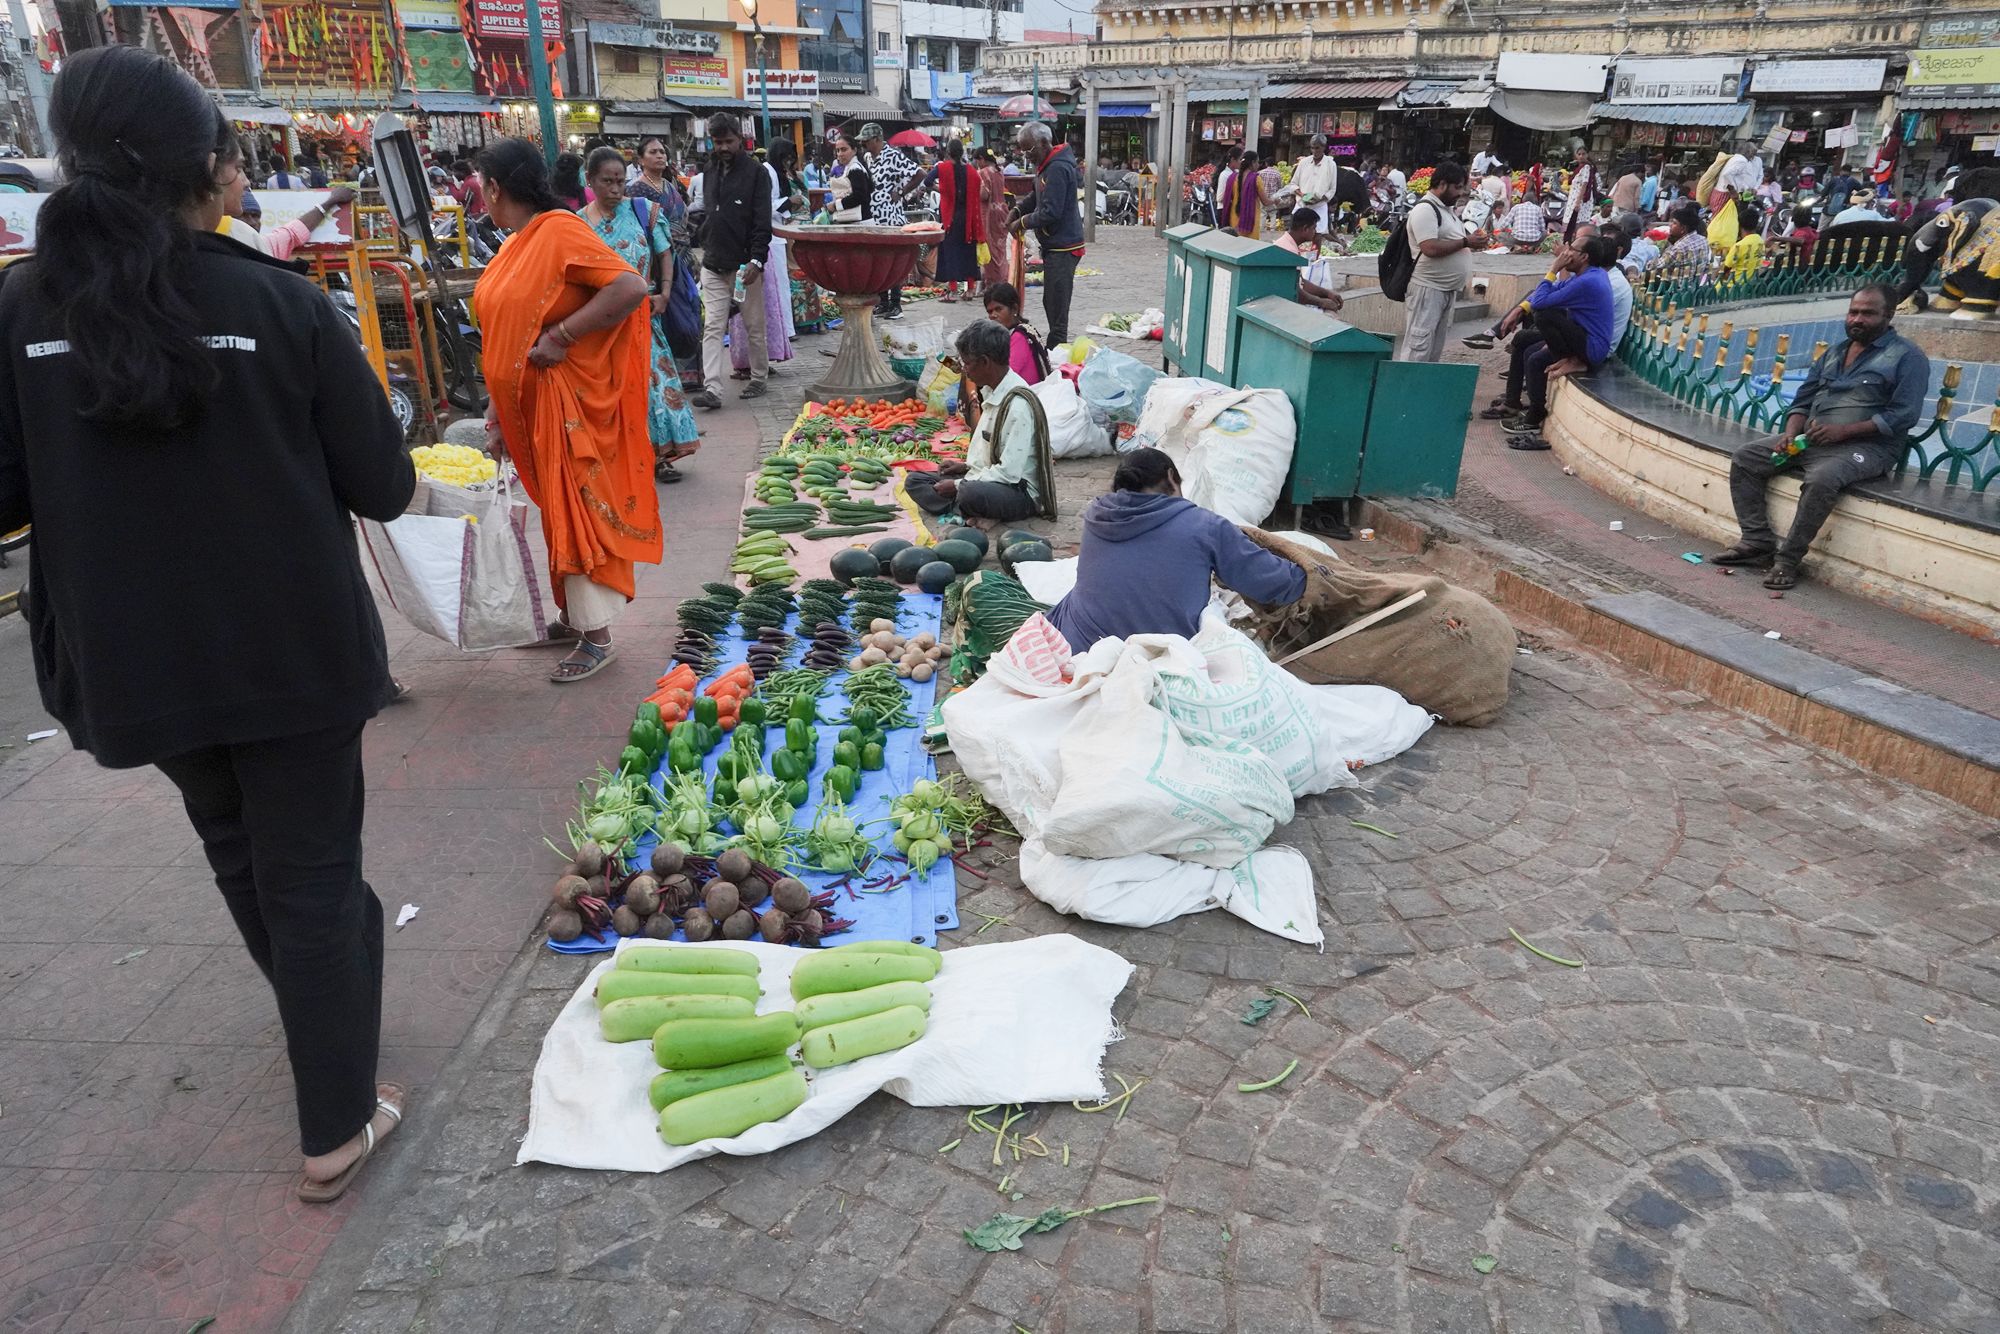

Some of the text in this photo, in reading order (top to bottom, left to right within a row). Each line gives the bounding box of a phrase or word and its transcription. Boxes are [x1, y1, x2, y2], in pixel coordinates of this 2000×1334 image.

[480, 15, 521, 27] JUPITER
[522, 18, 561, 30] SRES
[200, 335, 256, 352] CATION
[1221, 699, 1261, 727] NETT
[1240, 710, 1276, 740] 50 KG
[1258, 723, 1300, 755] FARMS
